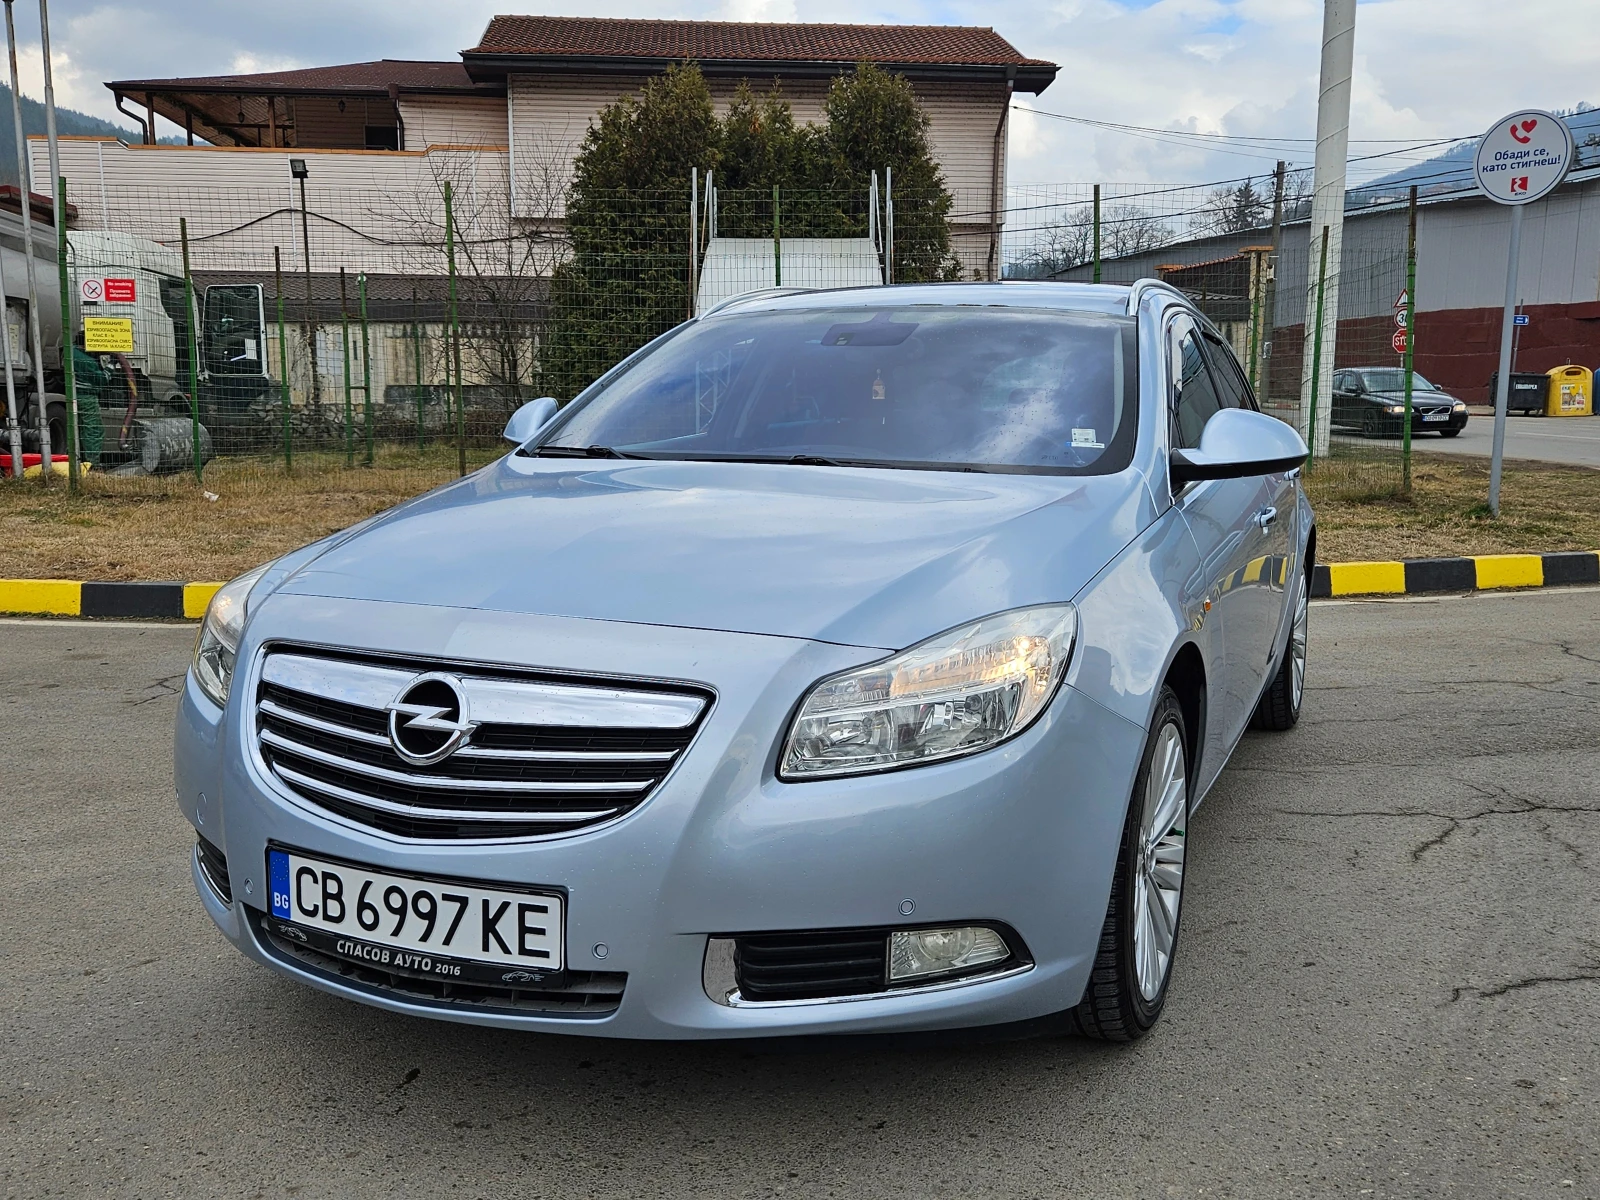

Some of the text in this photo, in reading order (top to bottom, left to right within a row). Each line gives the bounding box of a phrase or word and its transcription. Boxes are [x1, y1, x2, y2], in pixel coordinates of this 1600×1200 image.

[1482, 154, 1561, 173] като стигнеш!
[1494, 148, 1550, 161] Обади се,
[273, 891, 289, 910] BG
[295, 866, 551, 959] CB 6997 KE
[336, 939, 461, 976] СПАСОВ АУТО 2016
